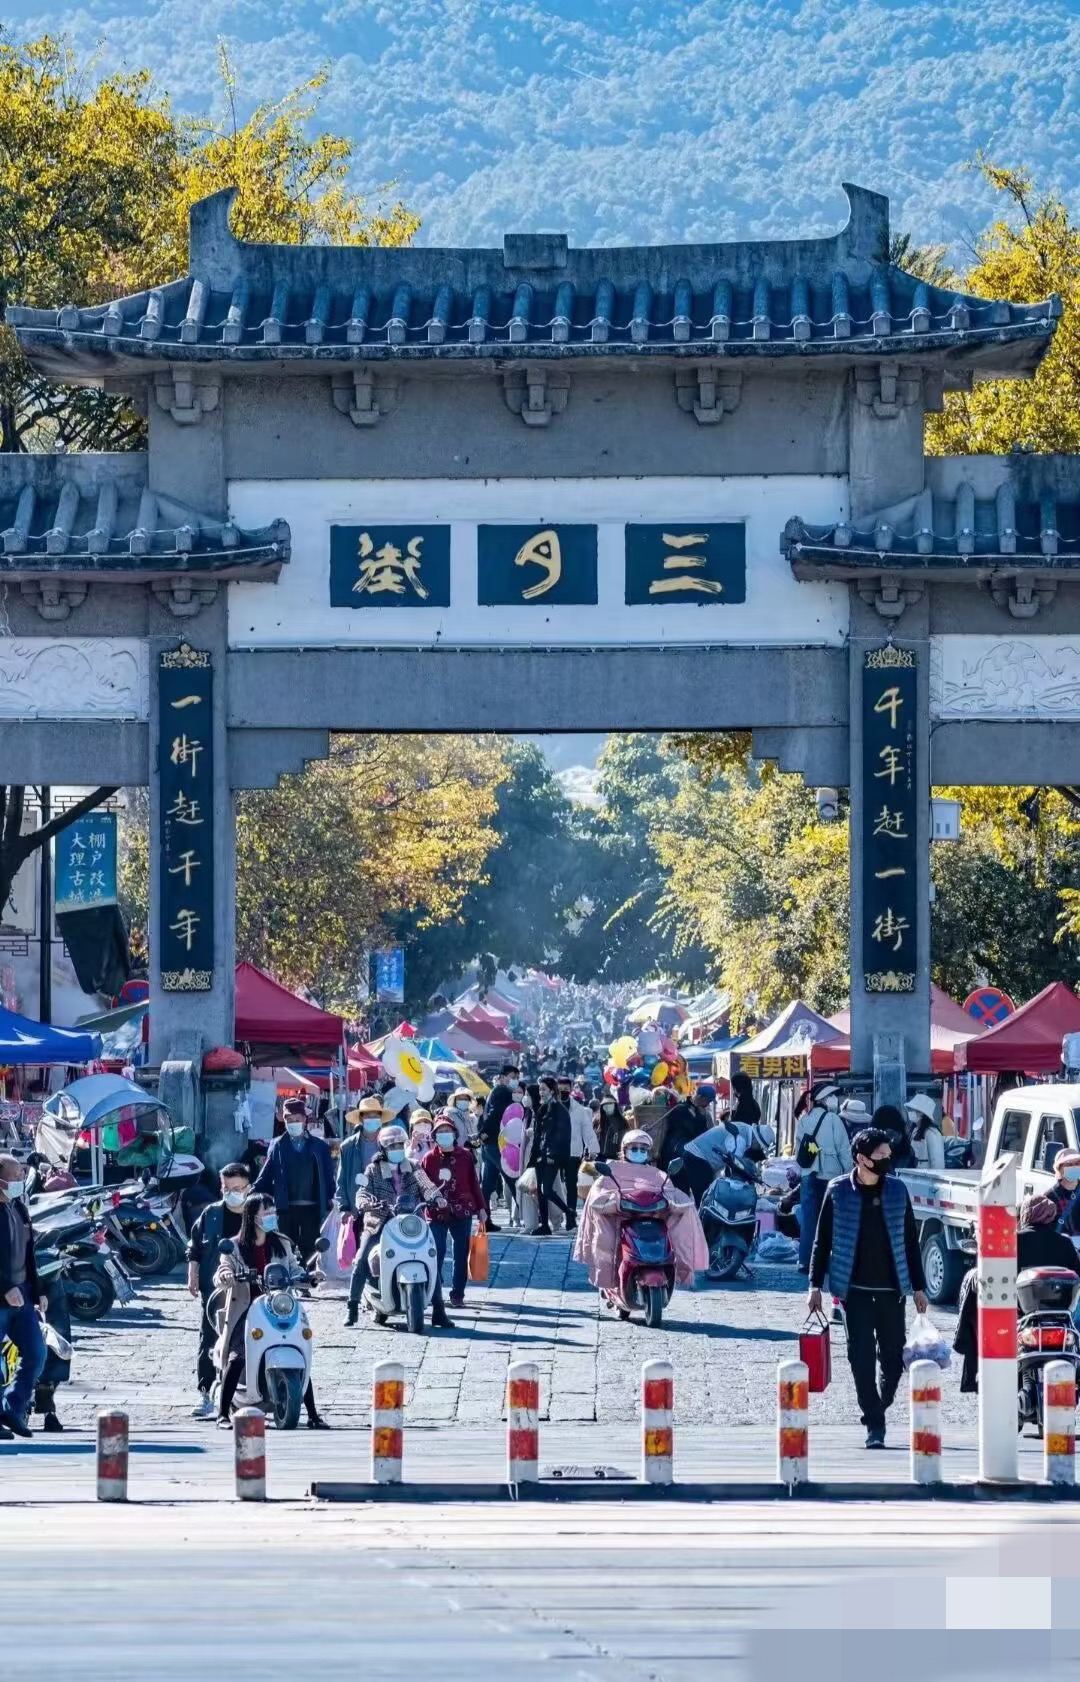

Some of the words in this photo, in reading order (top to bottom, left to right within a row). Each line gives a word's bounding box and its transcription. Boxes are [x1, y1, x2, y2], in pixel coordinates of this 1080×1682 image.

[352, 529, 724, 600] 三月街
[166, 694, 204, 951] 一街赶千年
[871, 687, 910, 951] 千年赶一街
[68, 832, 87, 904] 大理古城
[88, 832, 106, 904] 棚户改造
